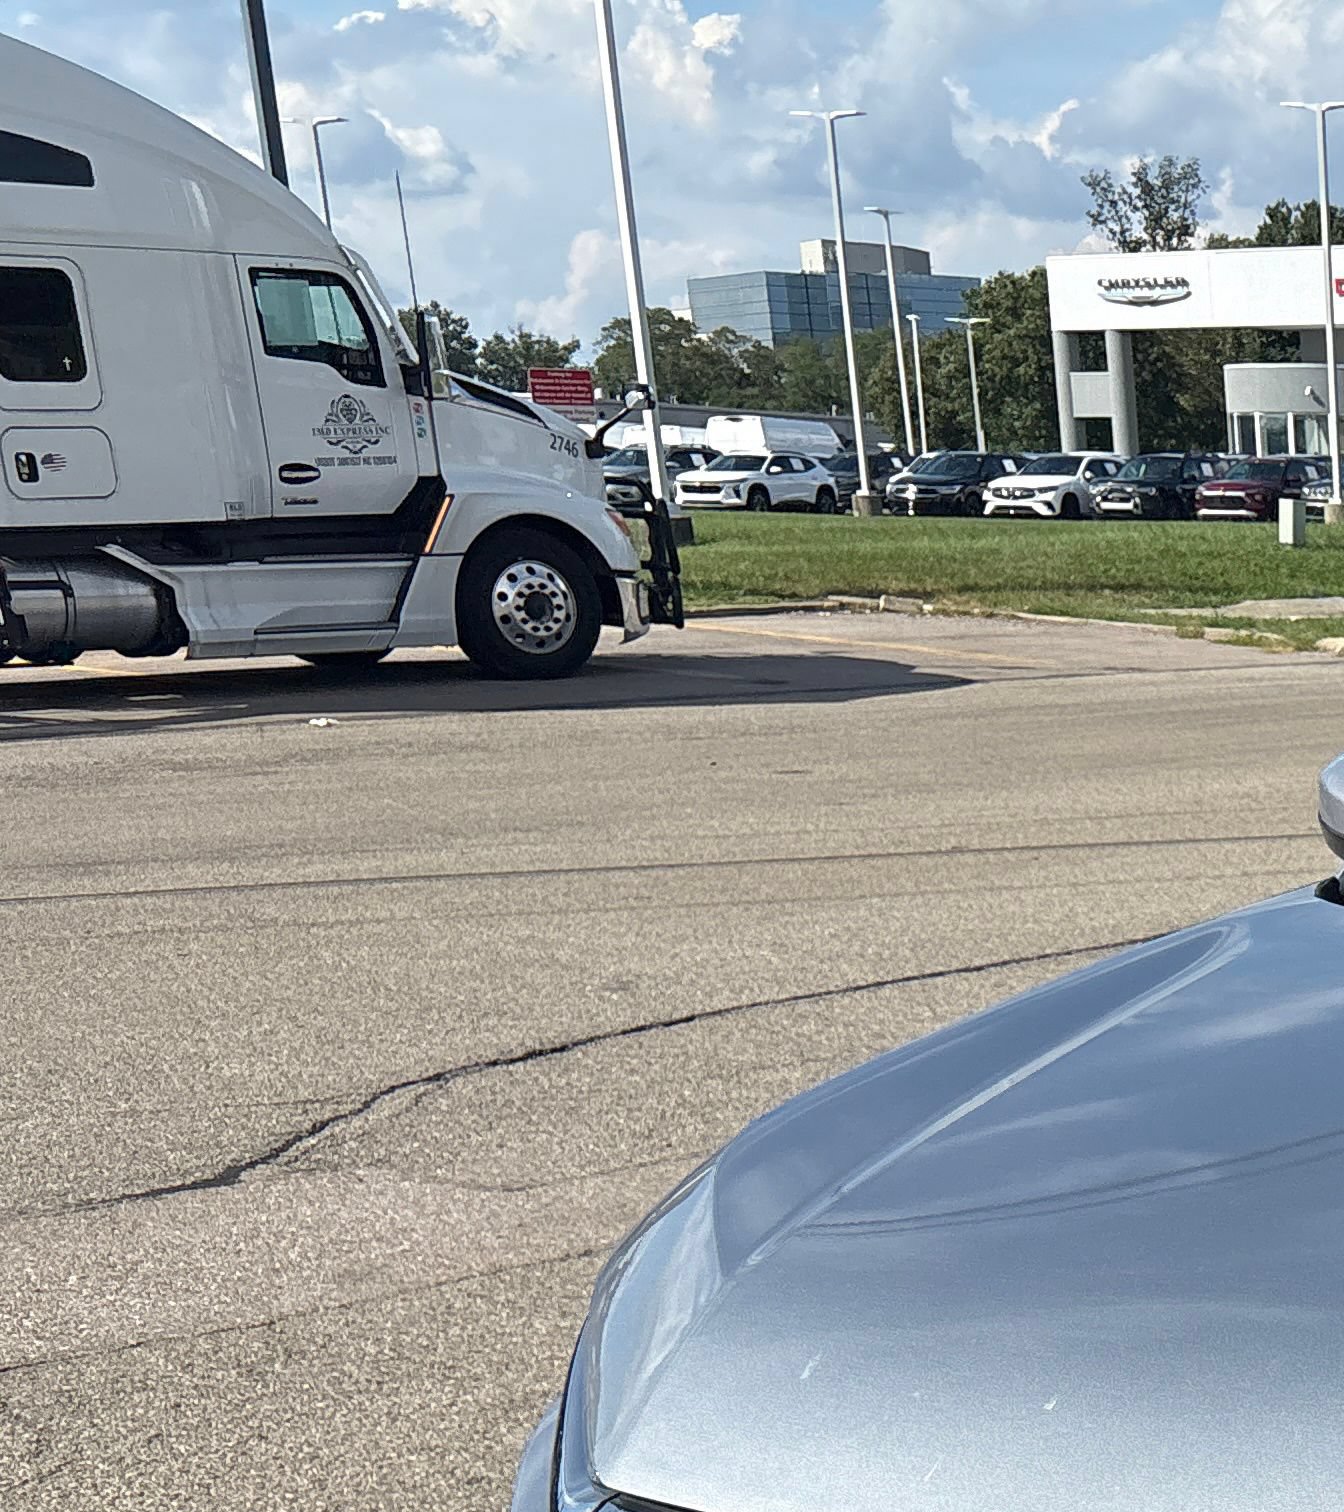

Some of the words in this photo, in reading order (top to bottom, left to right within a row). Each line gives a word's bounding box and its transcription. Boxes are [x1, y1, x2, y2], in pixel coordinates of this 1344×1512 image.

[1097, 276, 1190, 291] CHRYSLER
[333, 425, 374, 436] EXPRESS
[550, 433, 579, 458] 2746
